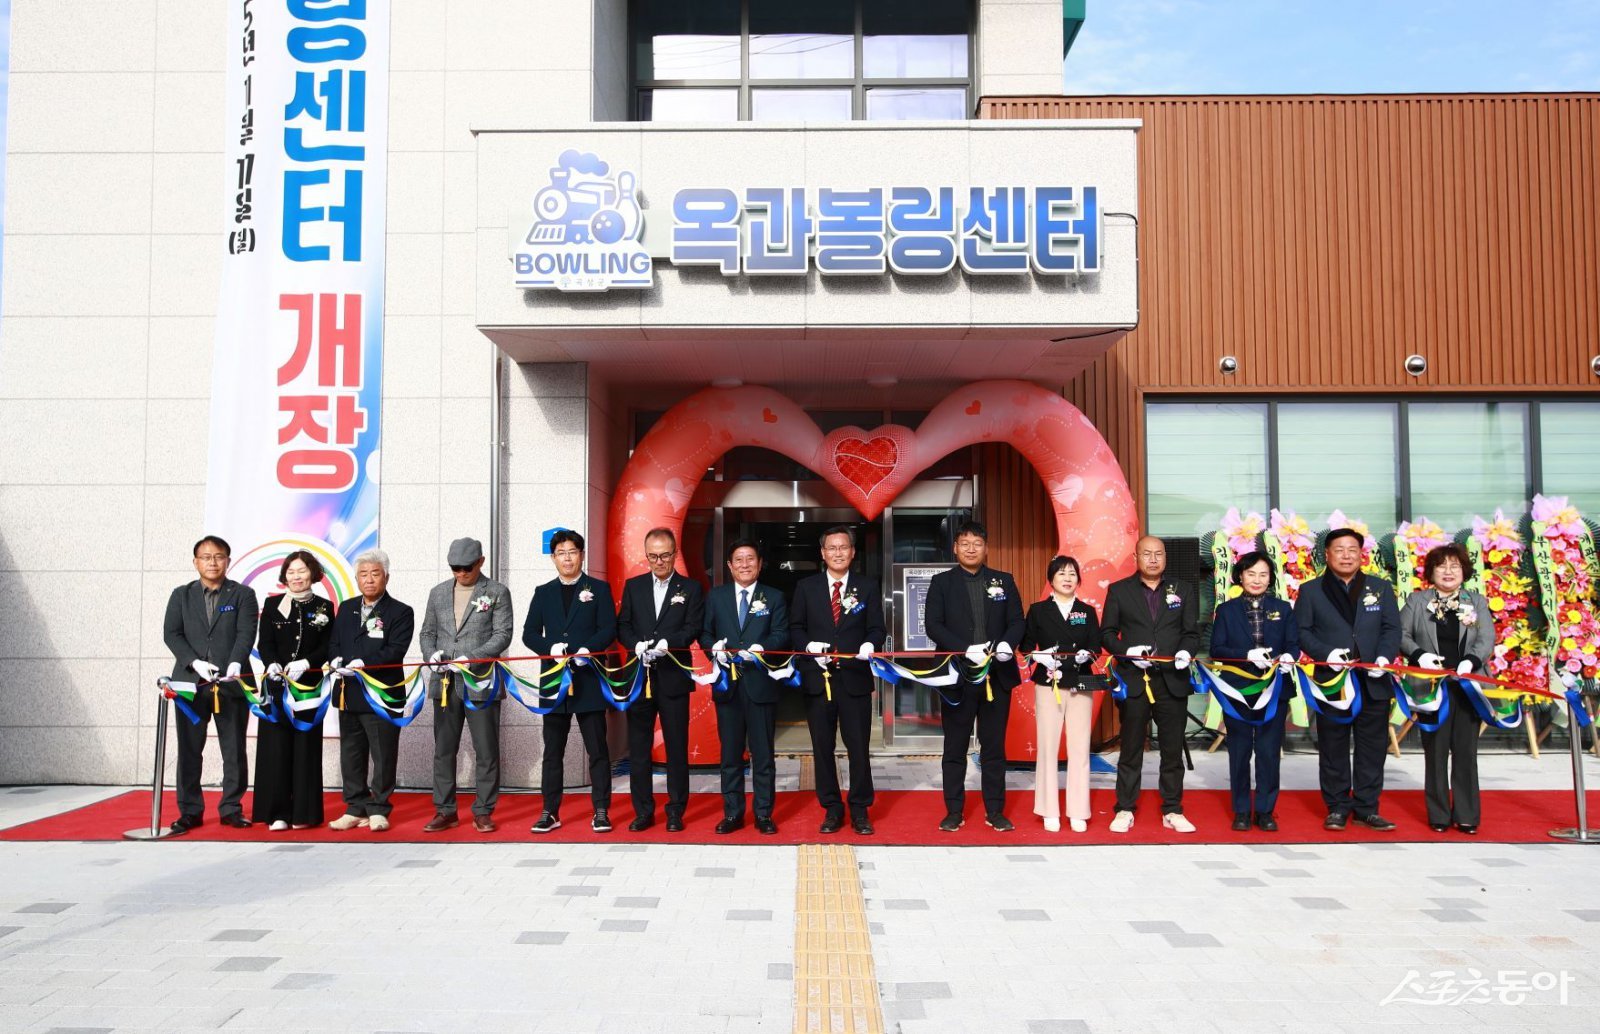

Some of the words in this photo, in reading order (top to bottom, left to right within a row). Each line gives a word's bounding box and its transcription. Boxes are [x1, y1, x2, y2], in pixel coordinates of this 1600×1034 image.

[515, 252, 651, 275] BOWLING
[672, 186, 1098, 272] 옥과볼링센터
[276, 292, 364, 490] 개장
